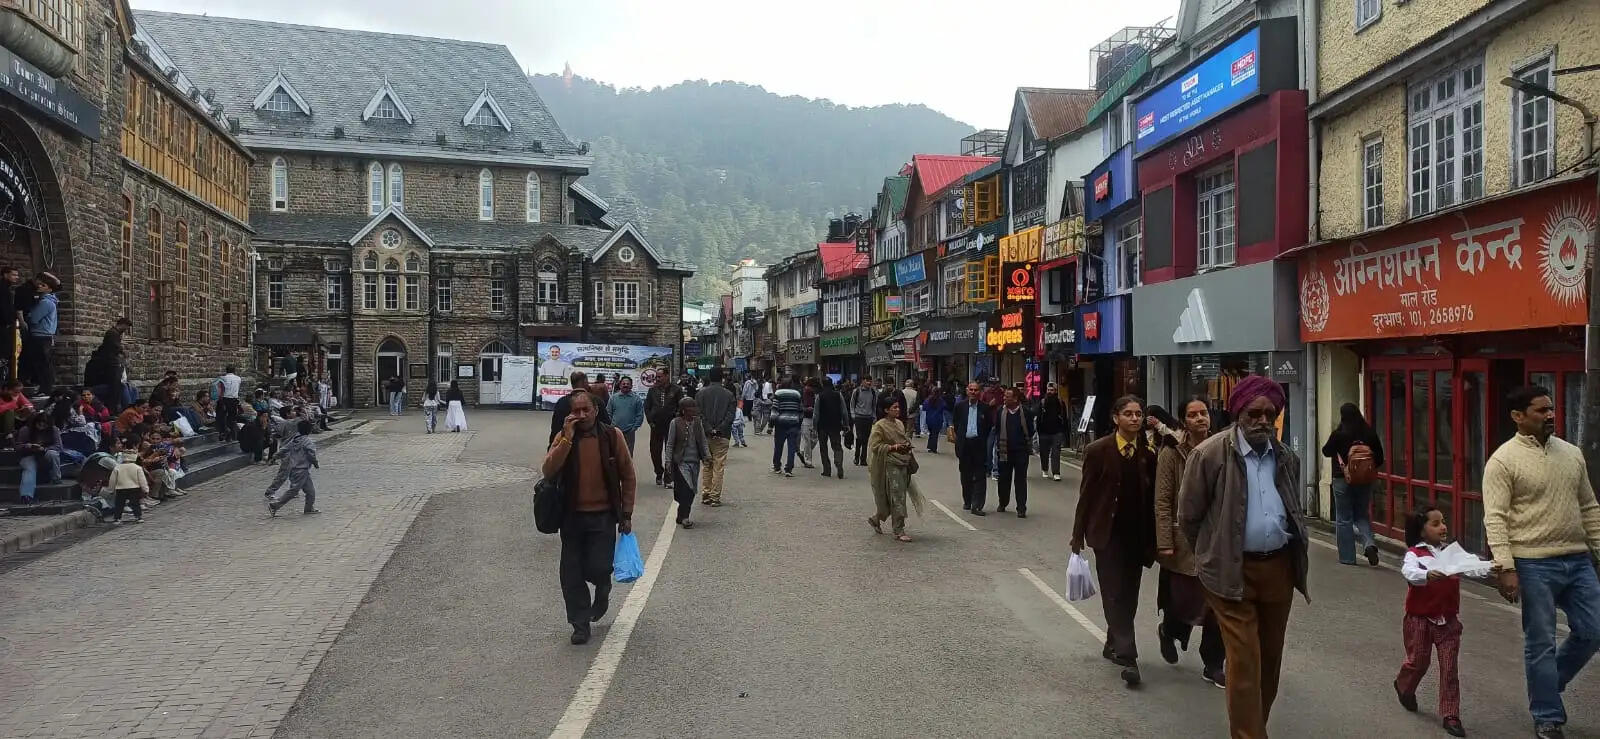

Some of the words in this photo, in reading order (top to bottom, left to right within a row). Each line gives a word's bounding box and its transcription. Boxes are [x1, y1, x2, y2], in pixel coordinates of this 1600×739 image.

[14, 60, 35, 84] Town
[38, 72, 54, 95] Hall
[1333, 237, 1442, 297] अग्निशमन
[1450, 211, 1525, 276] केन्द्र
[1400, 291, 1418, 307] माल
[1421, 283, 1438, 305] रोड
[1001, 312, 1022, 328] xero
[1430, 305, 1474, 325] 2658976
[987, 328, 1023, 351] degrees
